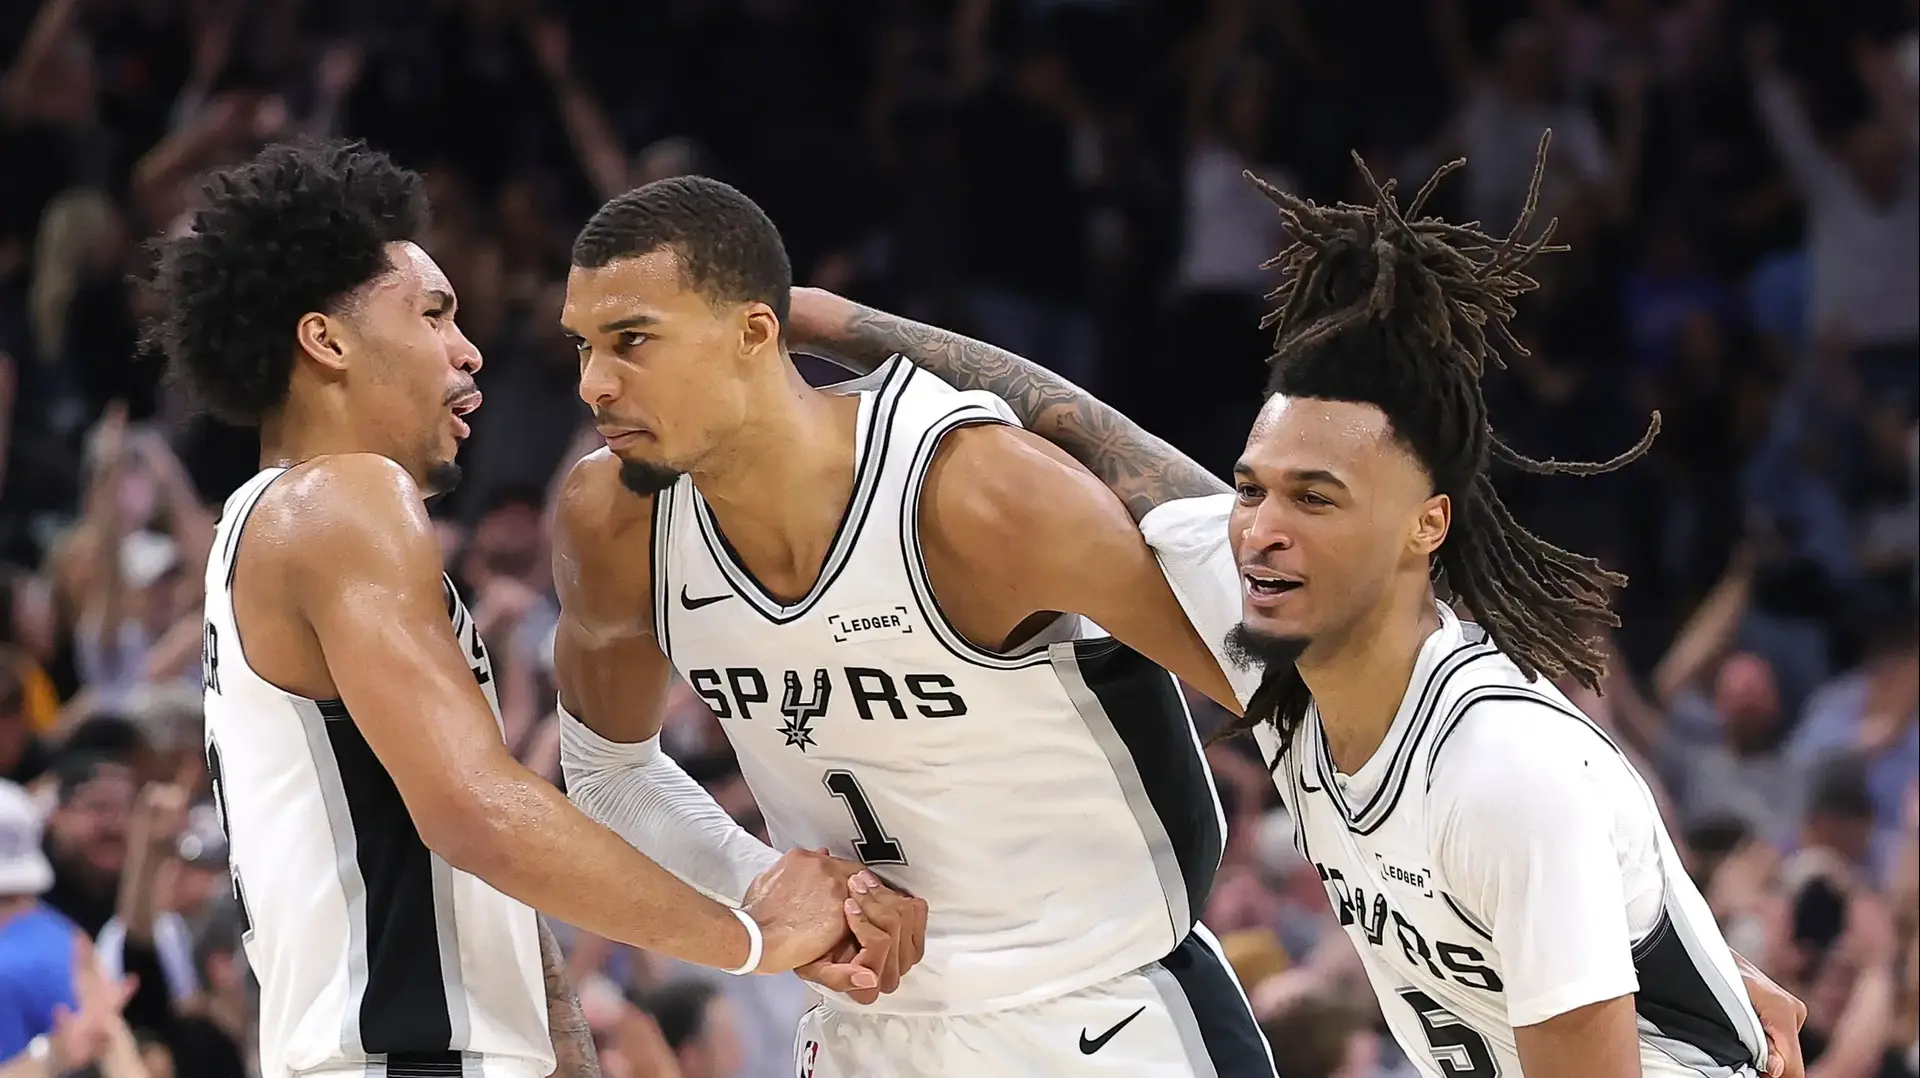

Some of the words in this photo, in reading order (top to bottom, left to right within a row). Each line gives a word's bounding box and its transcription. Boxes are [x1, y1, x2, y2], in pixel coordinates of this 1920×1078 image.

[840, 613, 901, 633] LEDGER
[690, 667, 967, 752] SPURS
[821, 769, 908, 866] 1
[1382, 862, 1425, 888] LEDGER
[1315, 862, 1504, 993] PURS
[1394, 985, 1503, 1078] 5
